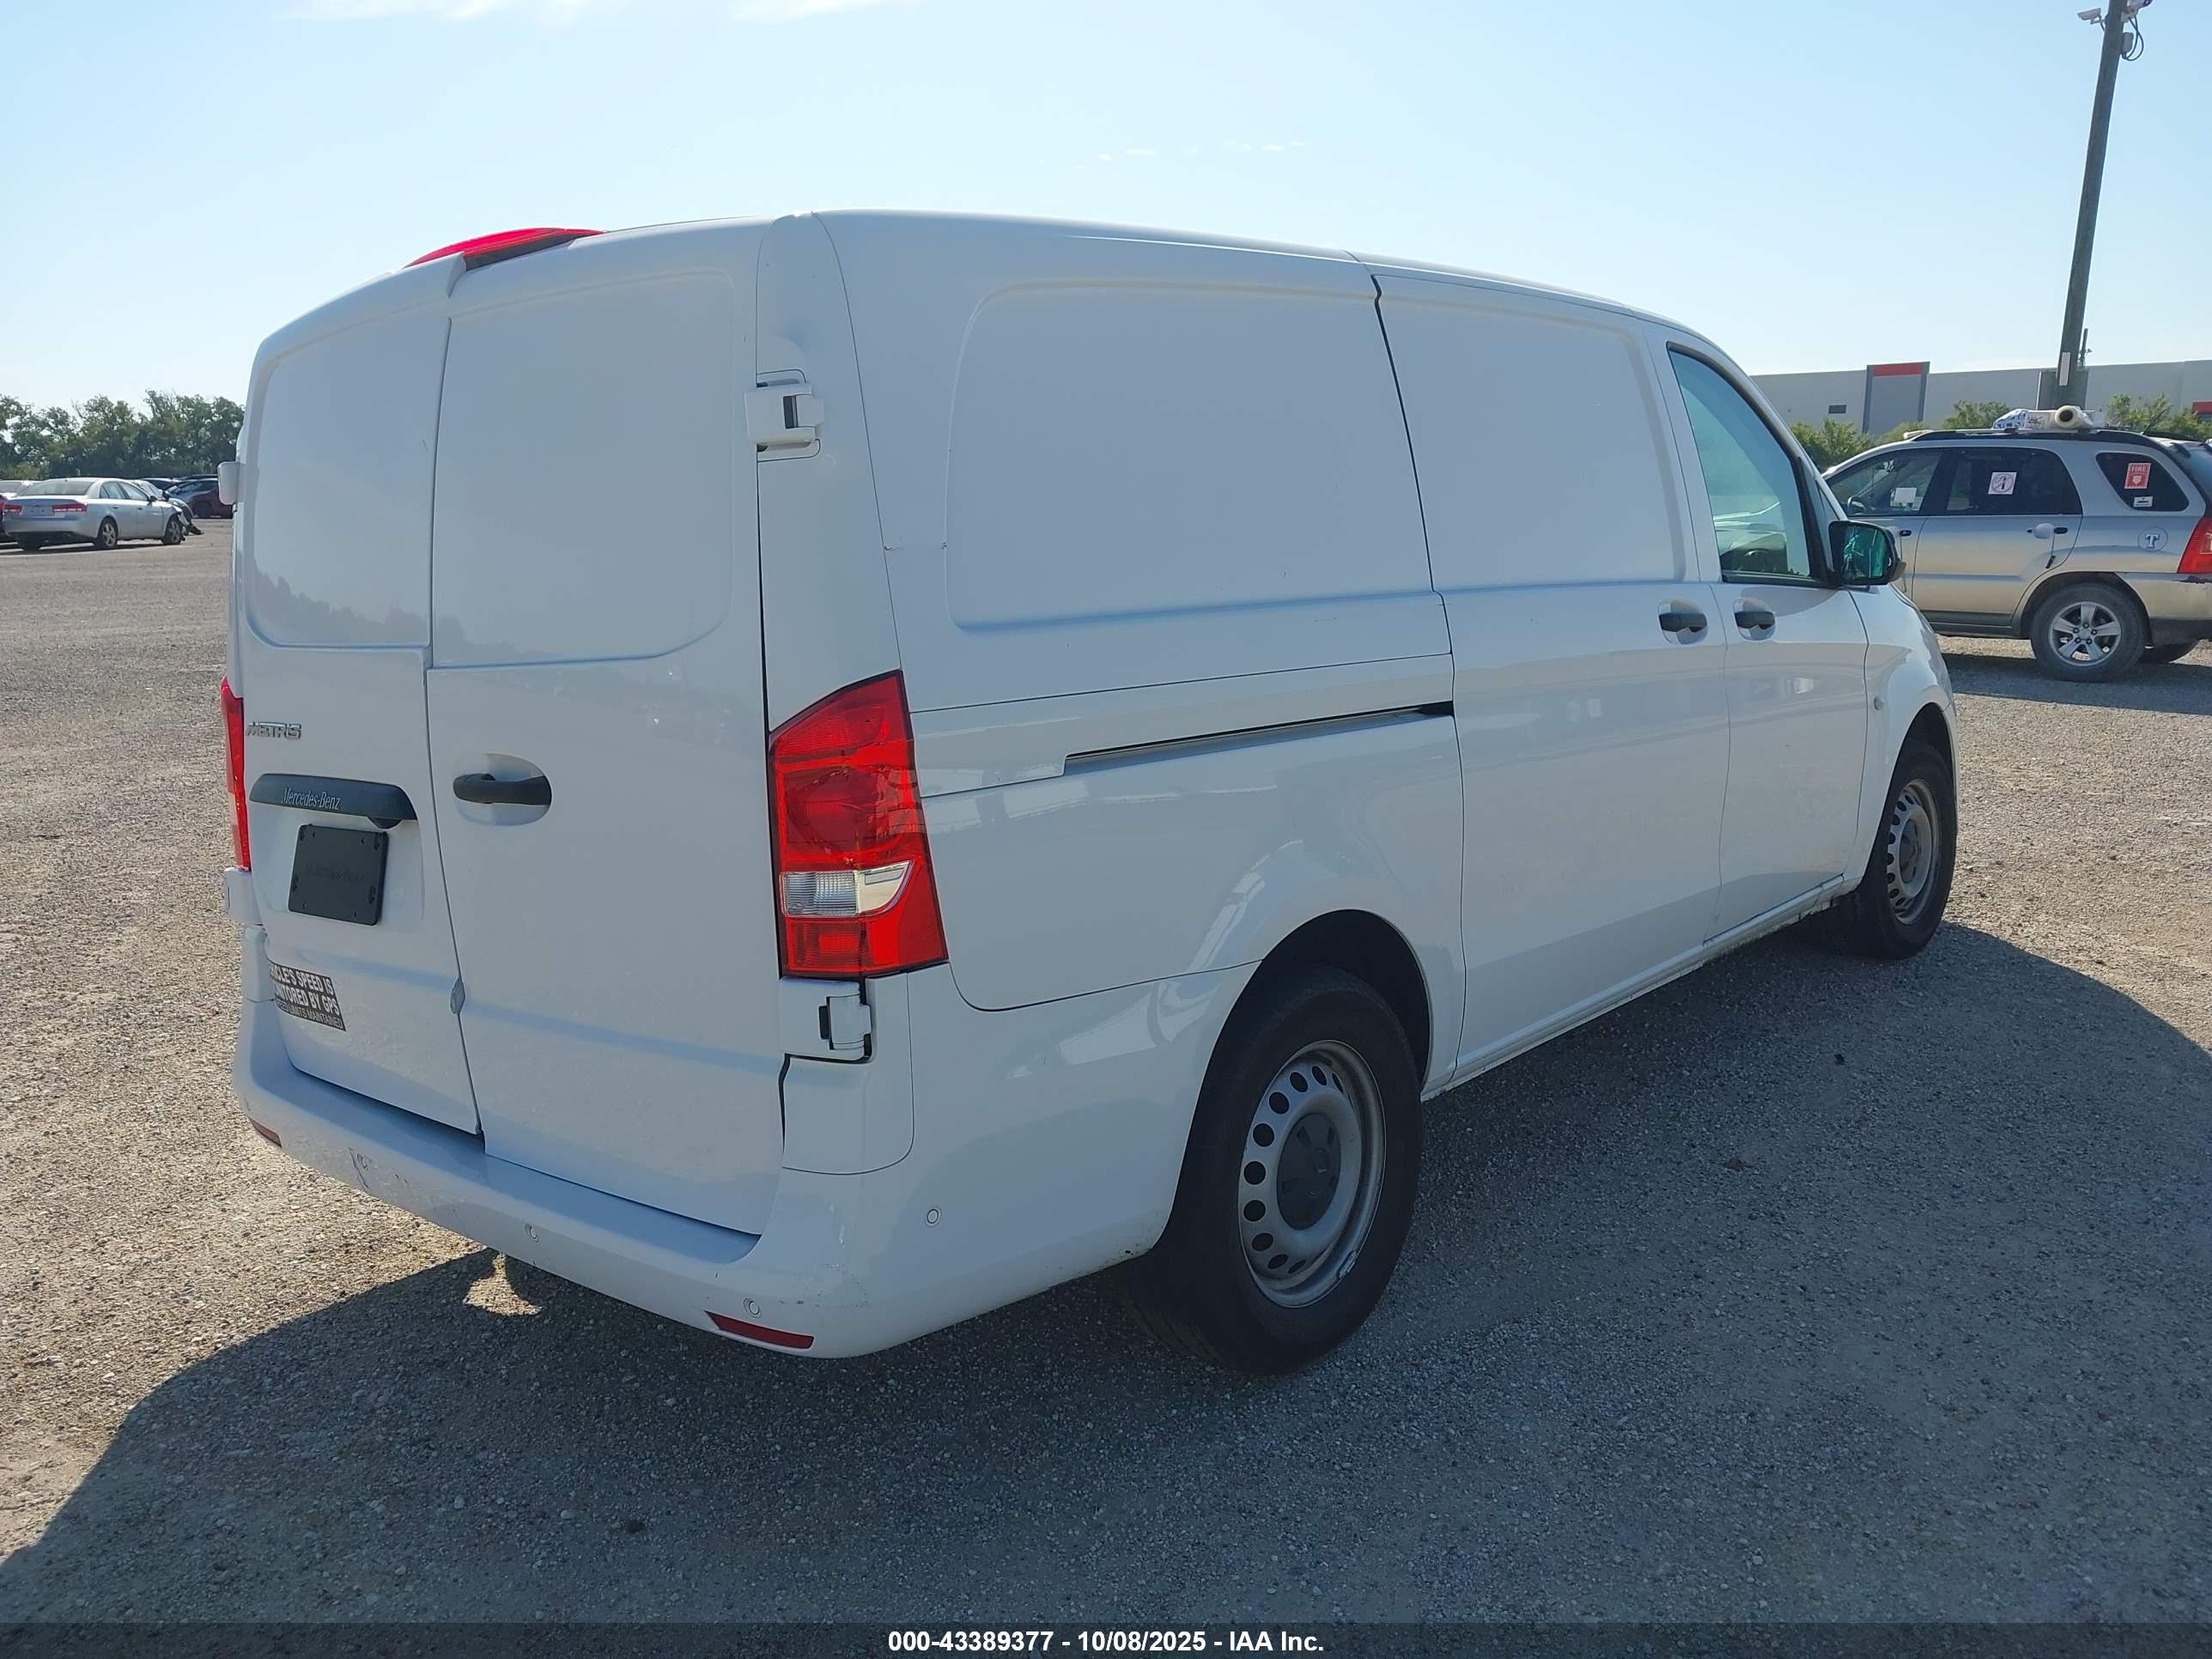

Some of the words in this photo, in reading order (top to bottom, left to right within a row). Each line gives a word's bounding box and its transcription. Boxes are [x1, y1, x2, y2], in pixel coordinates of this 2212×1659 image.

[2145, 534, 2160, 548] T
[281, 787, 341, 811] Mercedes-Benz
[295, 971, 324, 992] SPEED
[322, 977, 334, 996] IS
[308, 991, 322, 1011] BY
[321, 994, 340, 1016] GPS
